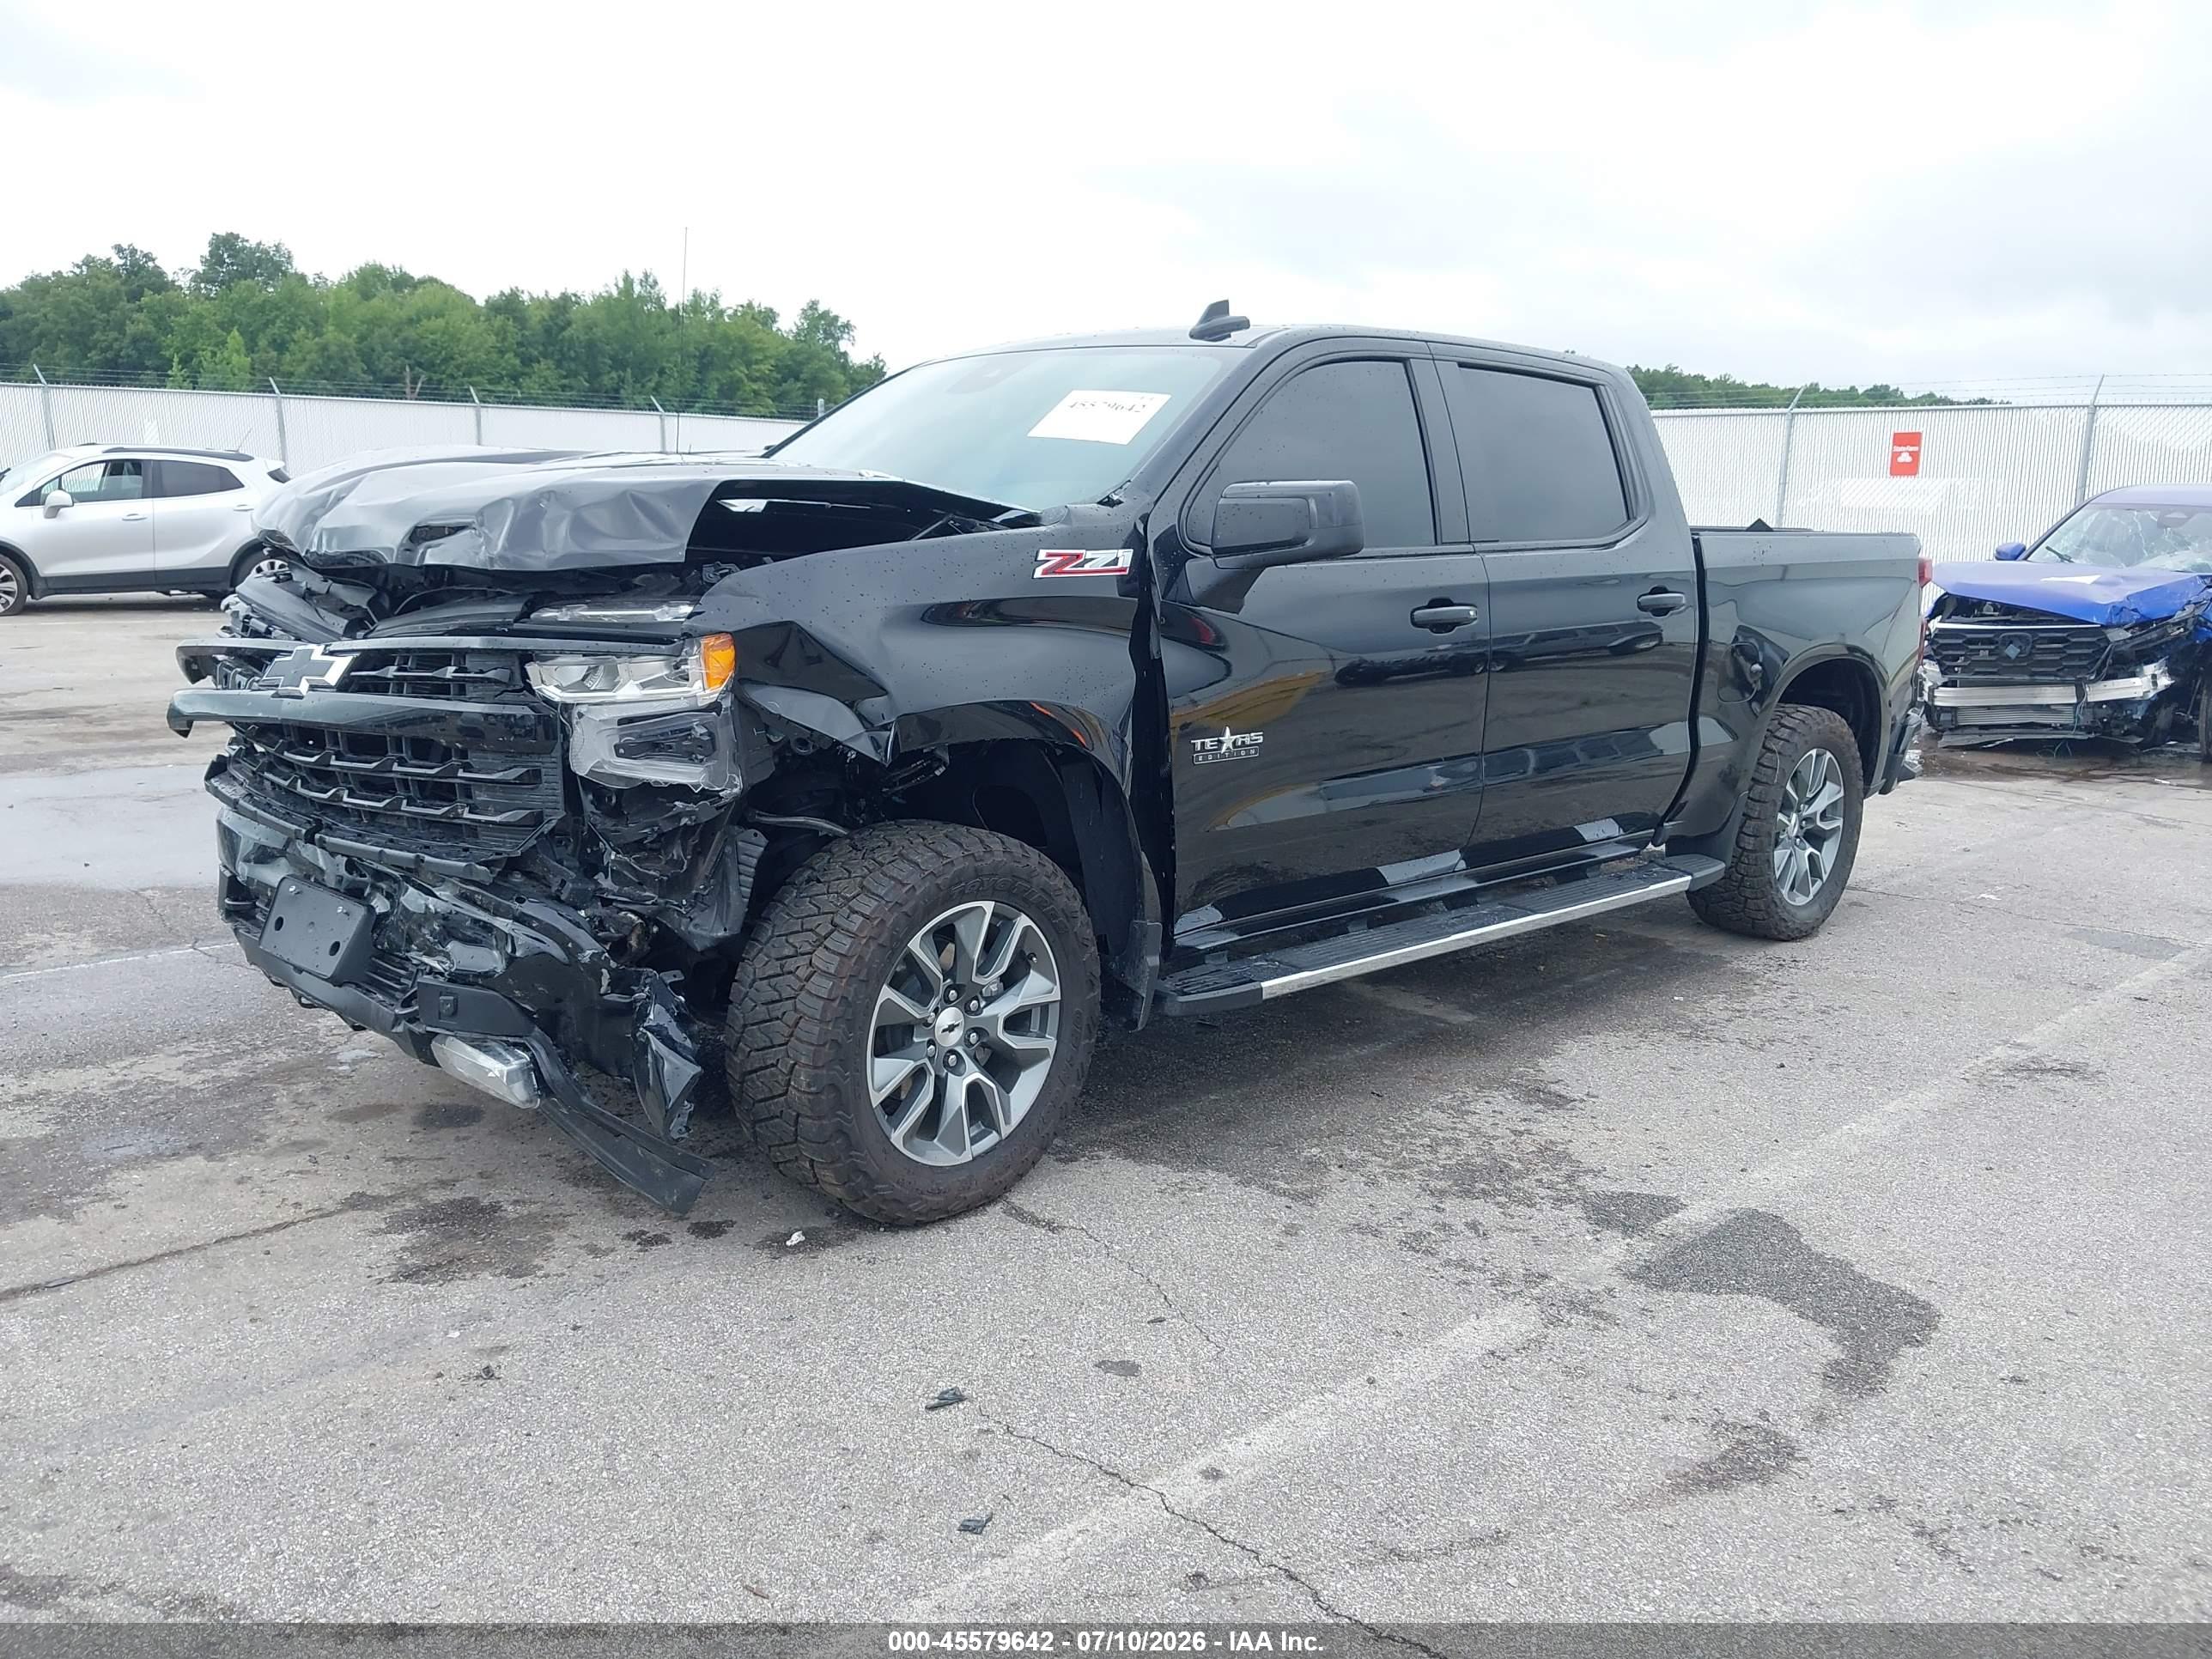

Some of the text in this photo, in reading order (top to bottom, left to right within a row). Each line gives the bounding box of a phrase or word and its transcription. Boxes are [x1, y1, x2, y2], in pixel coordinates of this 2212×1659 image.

[1032, 549, 1133, 578] Z71
[1190, 726, 1264, 754] TEXAS
[1198, 748, 1255, 762] EDITION
